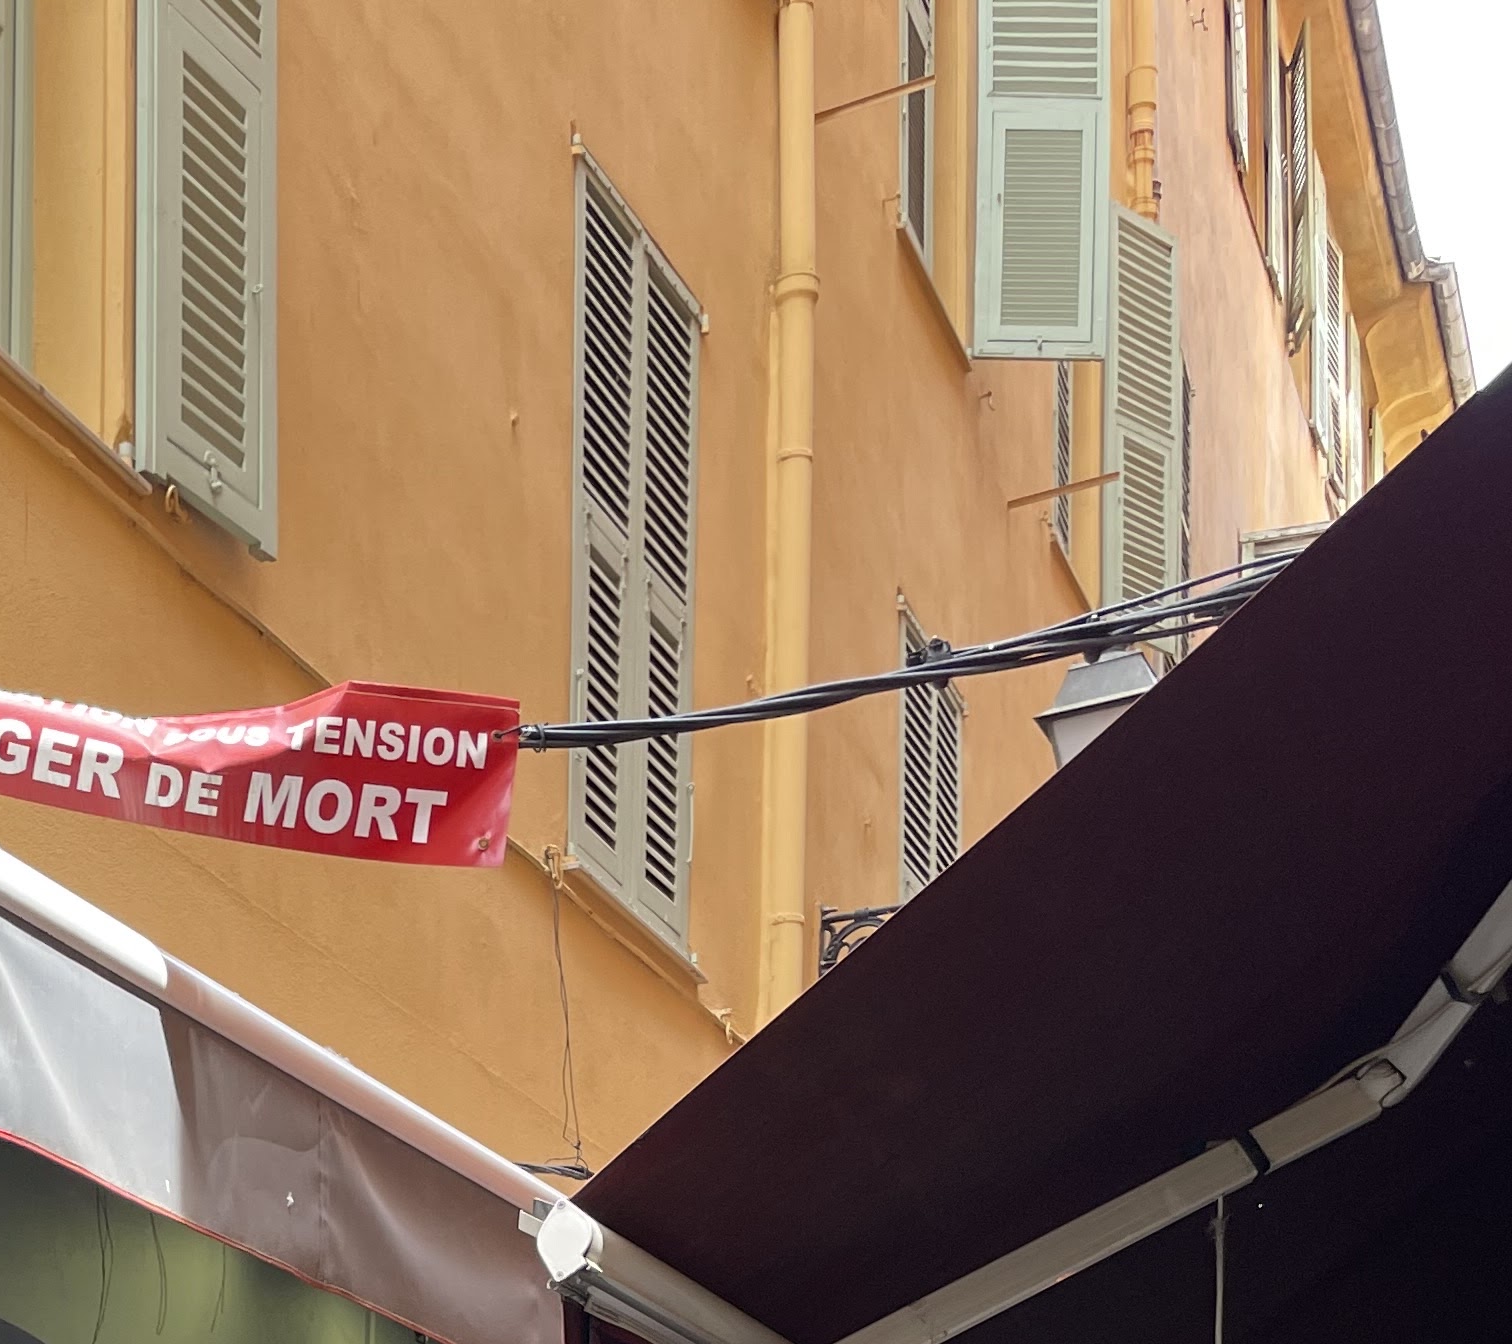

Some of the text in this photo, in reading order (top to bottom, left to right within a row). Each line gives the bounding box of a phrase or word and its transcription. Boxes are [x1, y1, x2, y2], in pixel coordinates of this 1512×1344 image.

[286, 715, 488, 770] TENSION
[144, 762, 222, 817] DE
[243, 771, 448, 844] MORT
